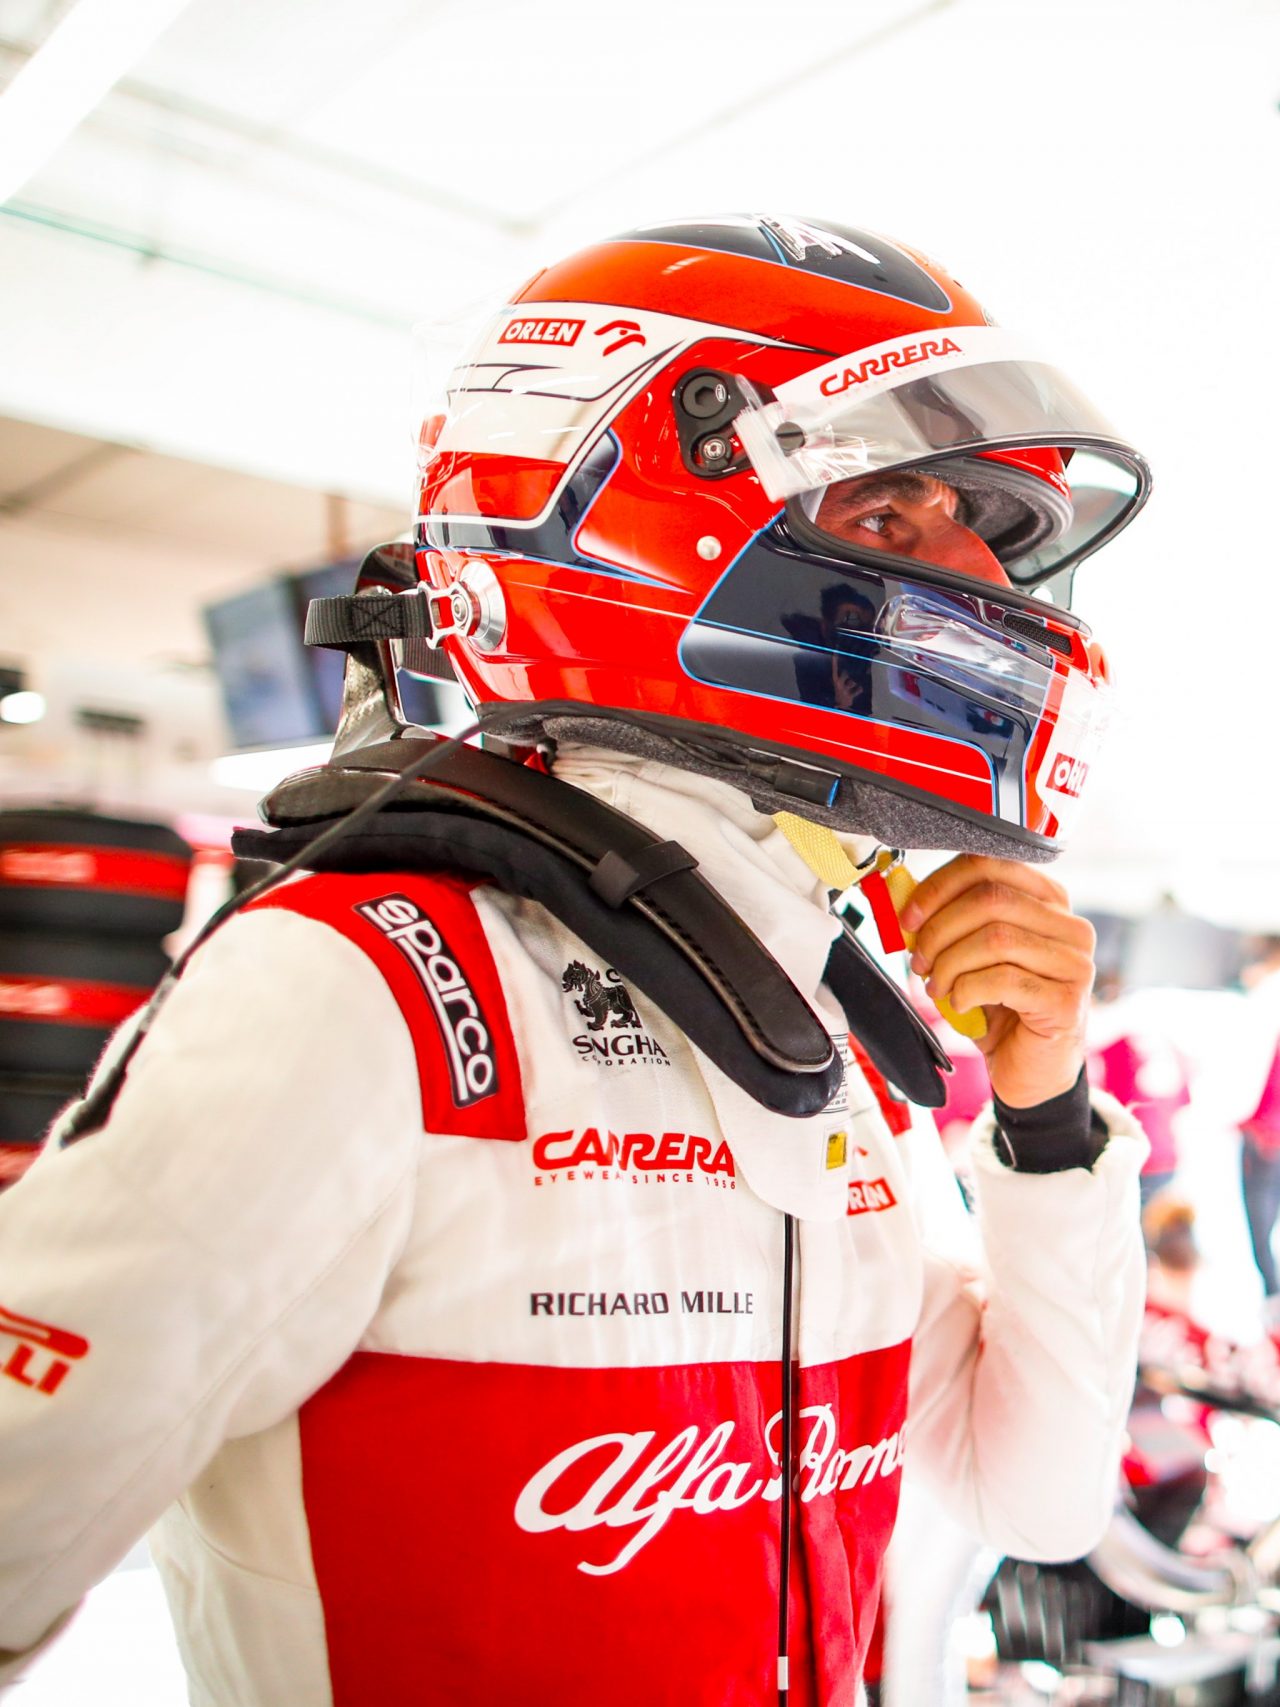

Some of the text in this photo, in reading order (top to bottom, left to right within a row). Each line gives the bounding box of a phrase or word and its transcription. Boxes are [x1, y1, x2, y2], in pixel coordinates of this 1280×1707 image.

[504, 321, 579, 343] ORLEN
[819, 337, 963, 397] CARRERA
[572, 1034, 668, 1058] SNGHA
[534, 1170, 625, 1187] EYEWEA
[632, 1172, 694, 1185] SINCE
[530, 1290, 754, 1316] RICHARD MILLE
[514, 1420, 761, 1577] Alfa
